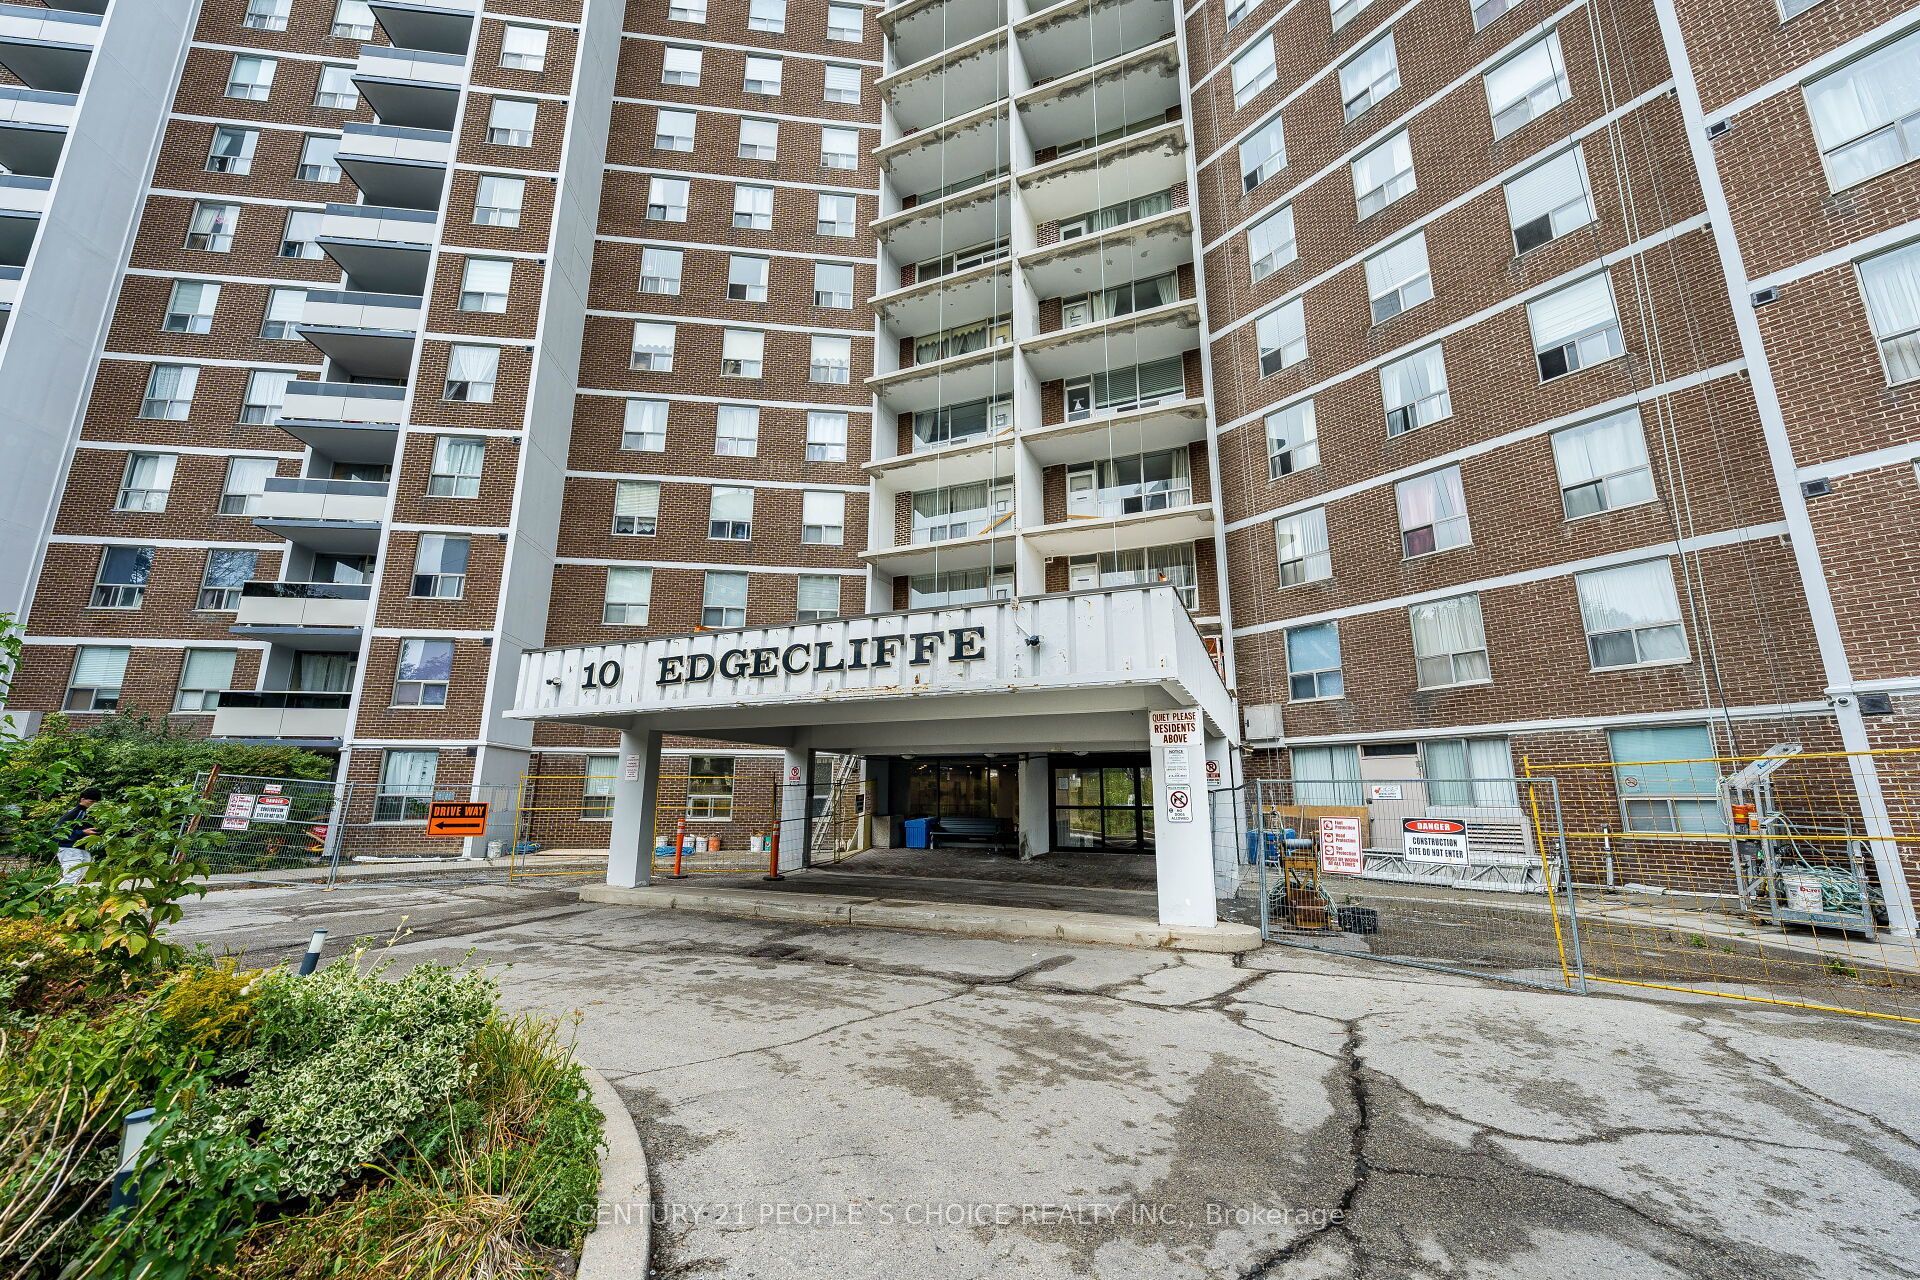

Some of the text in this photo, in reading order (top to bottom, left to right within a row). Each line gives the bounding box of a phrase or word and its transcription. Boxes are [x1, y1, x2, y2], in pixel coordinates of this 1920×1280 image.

[582, 626, 985, 689] 10 EDGECLIFFE
[1152, 711, 1196, 722] QUIET PLEASE
[1154, 722, 1196, 733] RESIDENTS
[1163, 733, 1188, 743] ABOVE
[433, 806, 485, 816] DRIVE WAY
[1416, 822, 1450, 831] DANGER
[1412, 837, 1458, 847] CONSTRUCTION
[1408, 847, 1464, 858] SITE DO NOT ENTER
